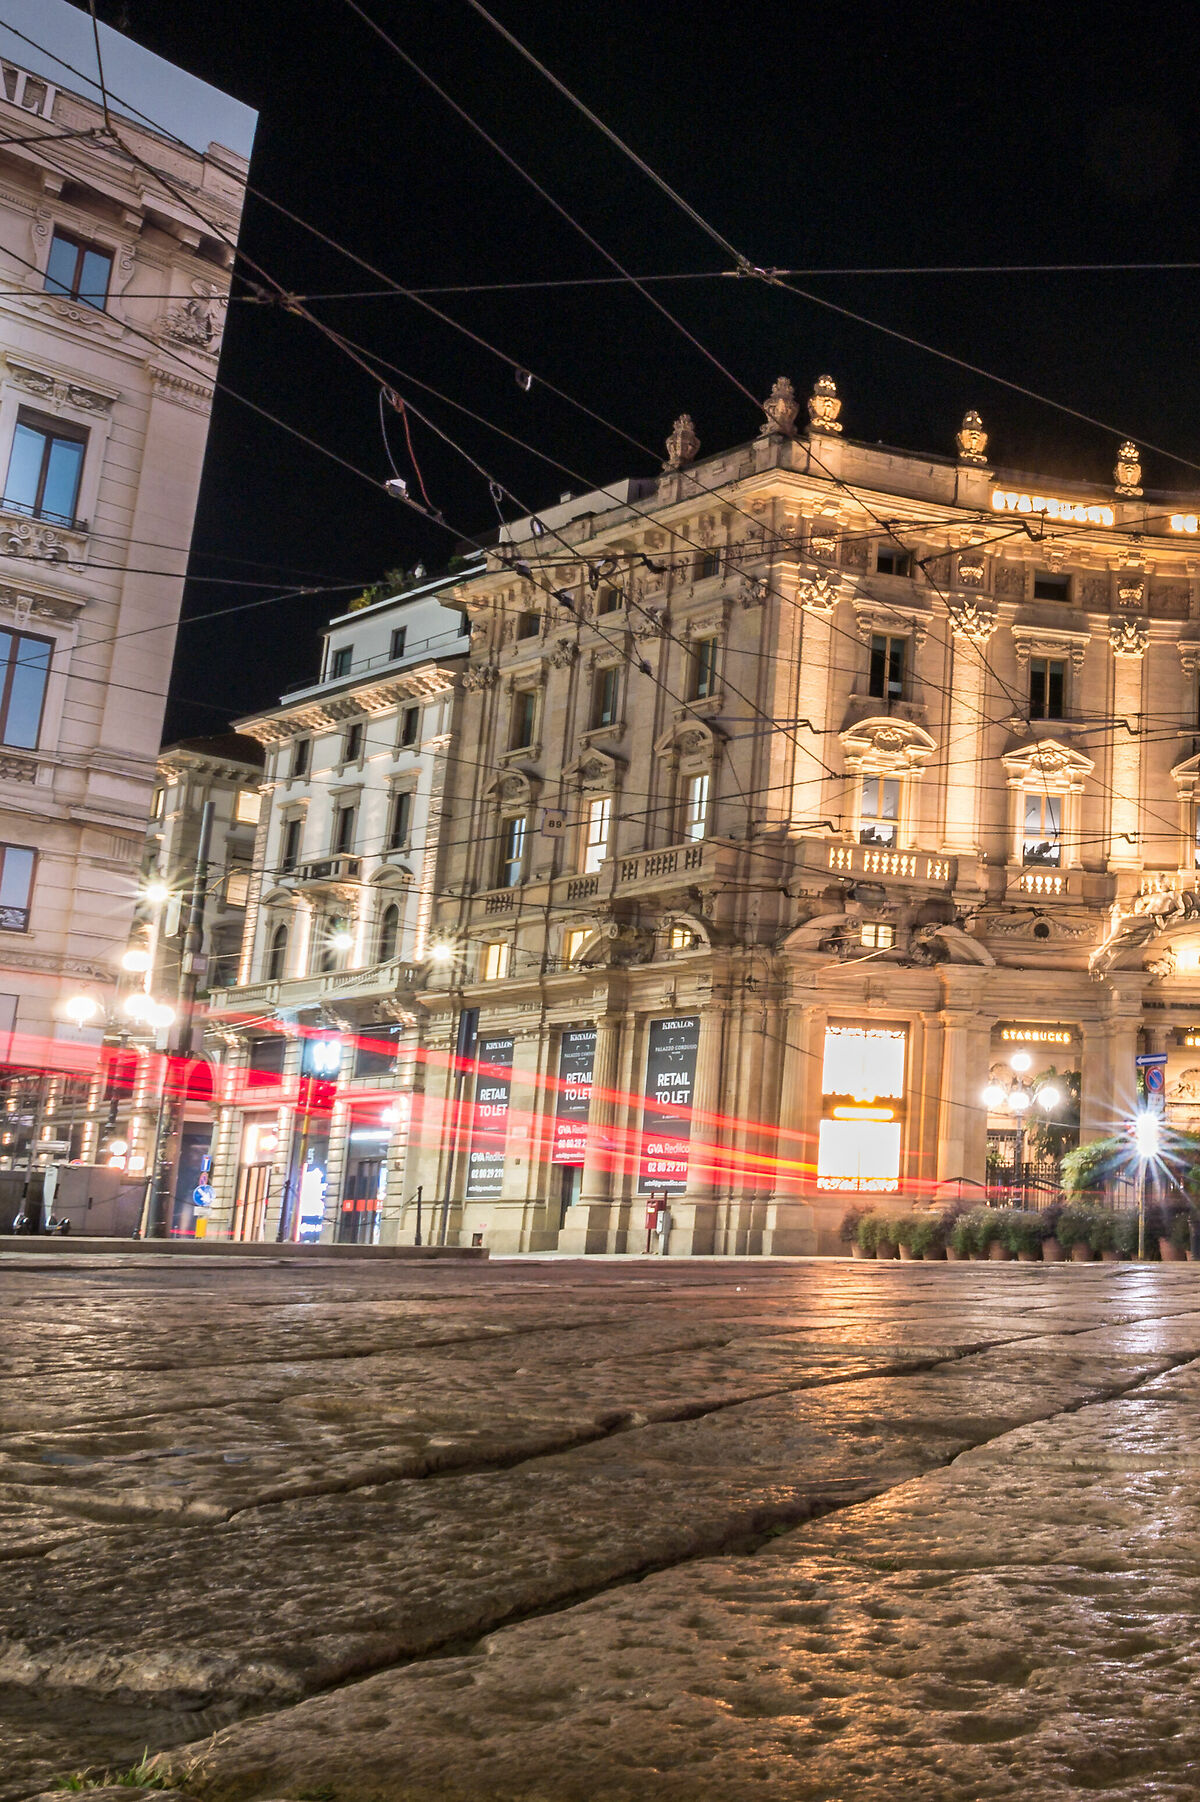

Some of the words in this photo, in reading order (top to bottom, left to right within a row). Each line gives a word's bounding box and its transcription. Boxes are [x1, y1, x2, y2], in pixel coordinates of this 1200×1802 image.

[1002, 1029, 1071, 1044] STARBUCKS
[566, 1072, 593, 1085] RETAIL
[657, 1072, 691, 1087] RETAIL
[480, 1088, 508, 1101] RETAIL
[564, 1089, 577, 1101] TO
[655, 1091, 670, 1105] TO
[671, 1090, 691, 1104] LET
[479, 1104, 491, 1117] TO
[492, 1103, 508, 1117] LET
[647, 1143, 664, 1155] GVA
[647, 1162, 657, 1173] 02
[666, 1161, 676, 1172] 29
[675, 1161, 688, 1172] 211
